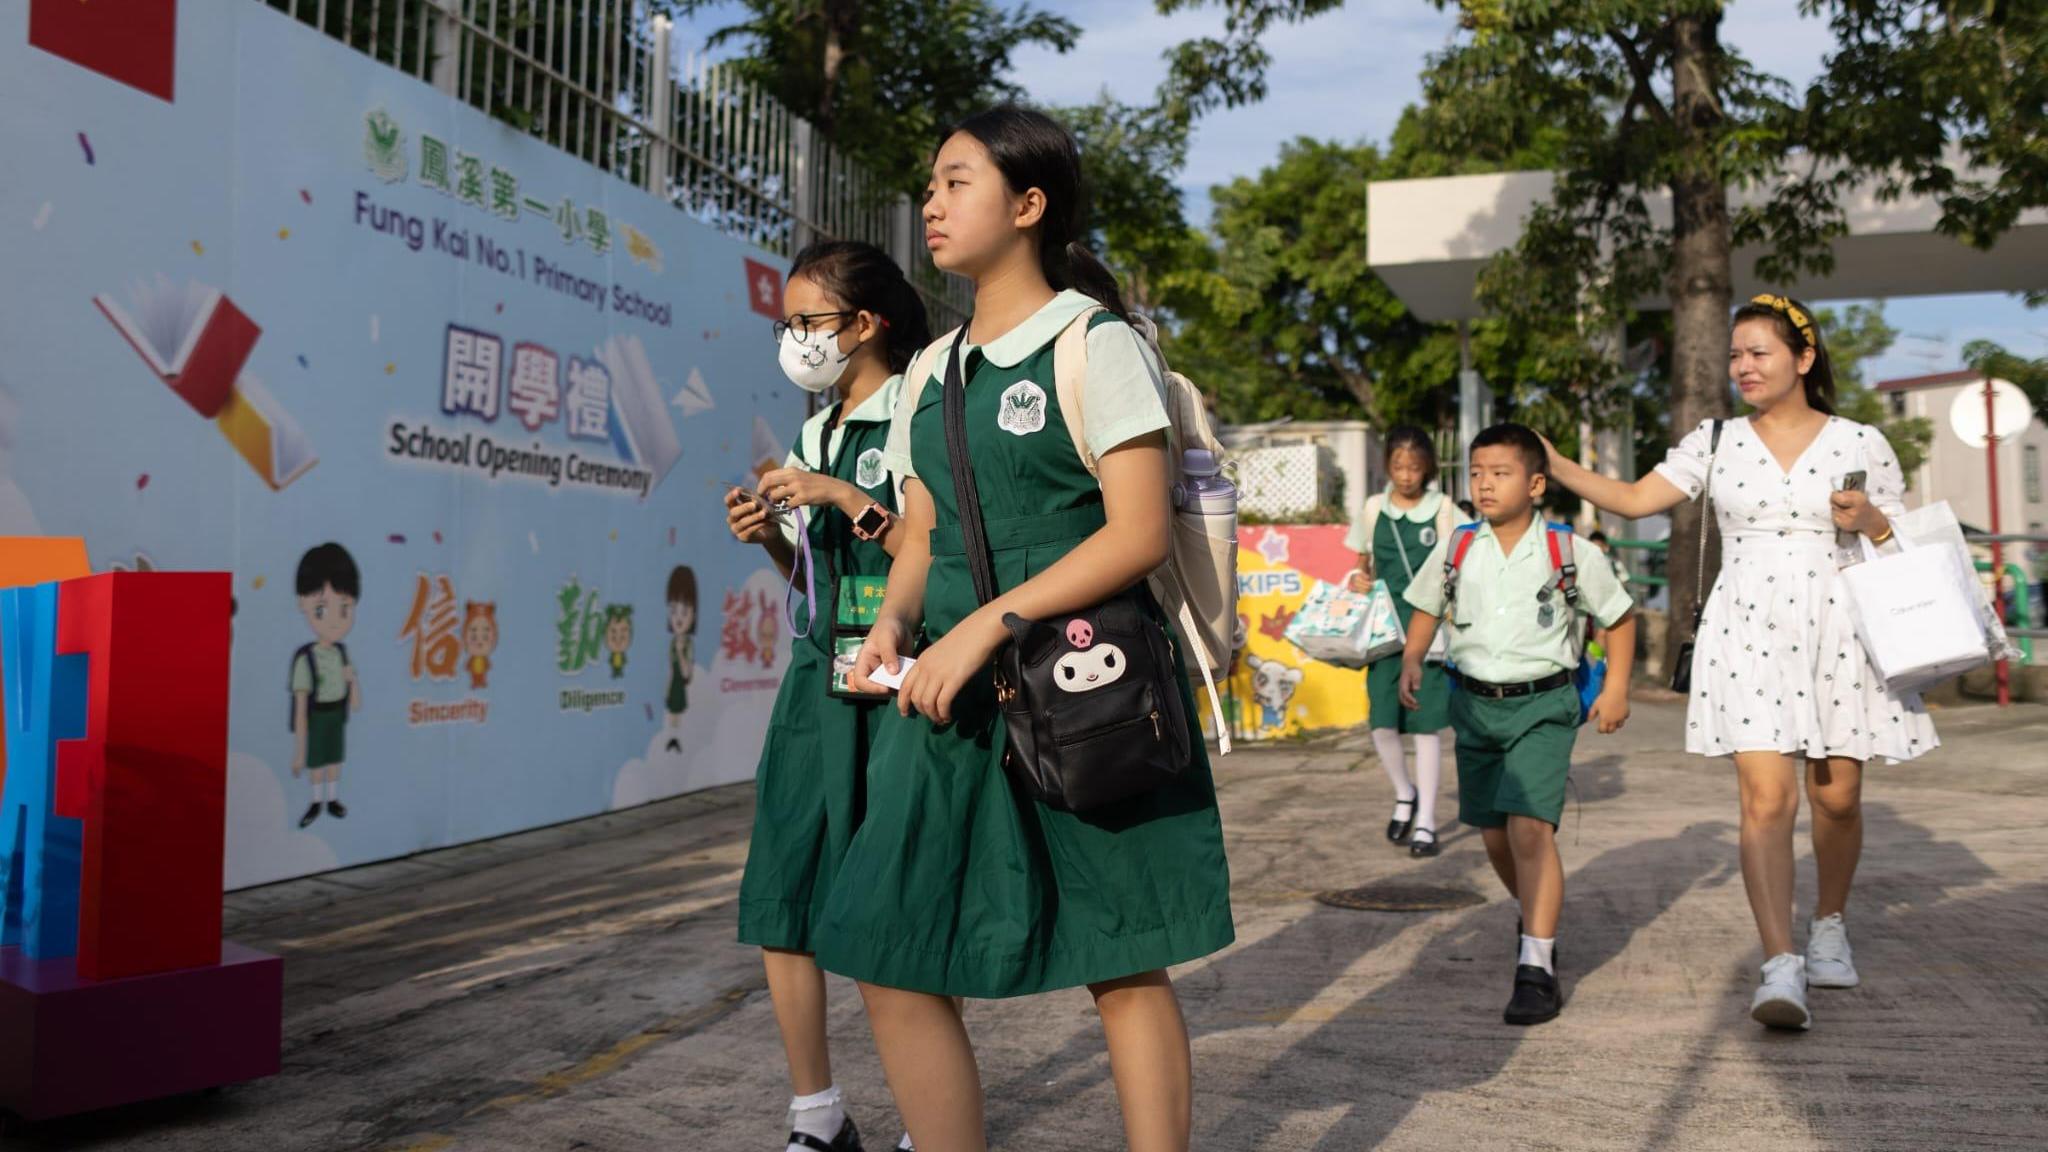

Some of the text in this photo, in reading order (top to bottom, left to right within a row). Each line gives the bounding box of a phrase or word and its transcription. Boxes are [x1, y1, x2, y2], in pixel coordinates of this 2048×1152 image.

[419, 133, 612, 253] 鳳溪第一小學
[354, 190, 673, 328] Fung Kai No.1 Primary School
[442, 323, 612, 444] 開學禮
[390, 422, 653, 498] School Opening Ceremony
[400, 574, 460, 679] 信
[557, 577, 605, 671] 勤
[408, 698, 488, 725] Sincerity
[560, 690, 625, 713] Diligence
